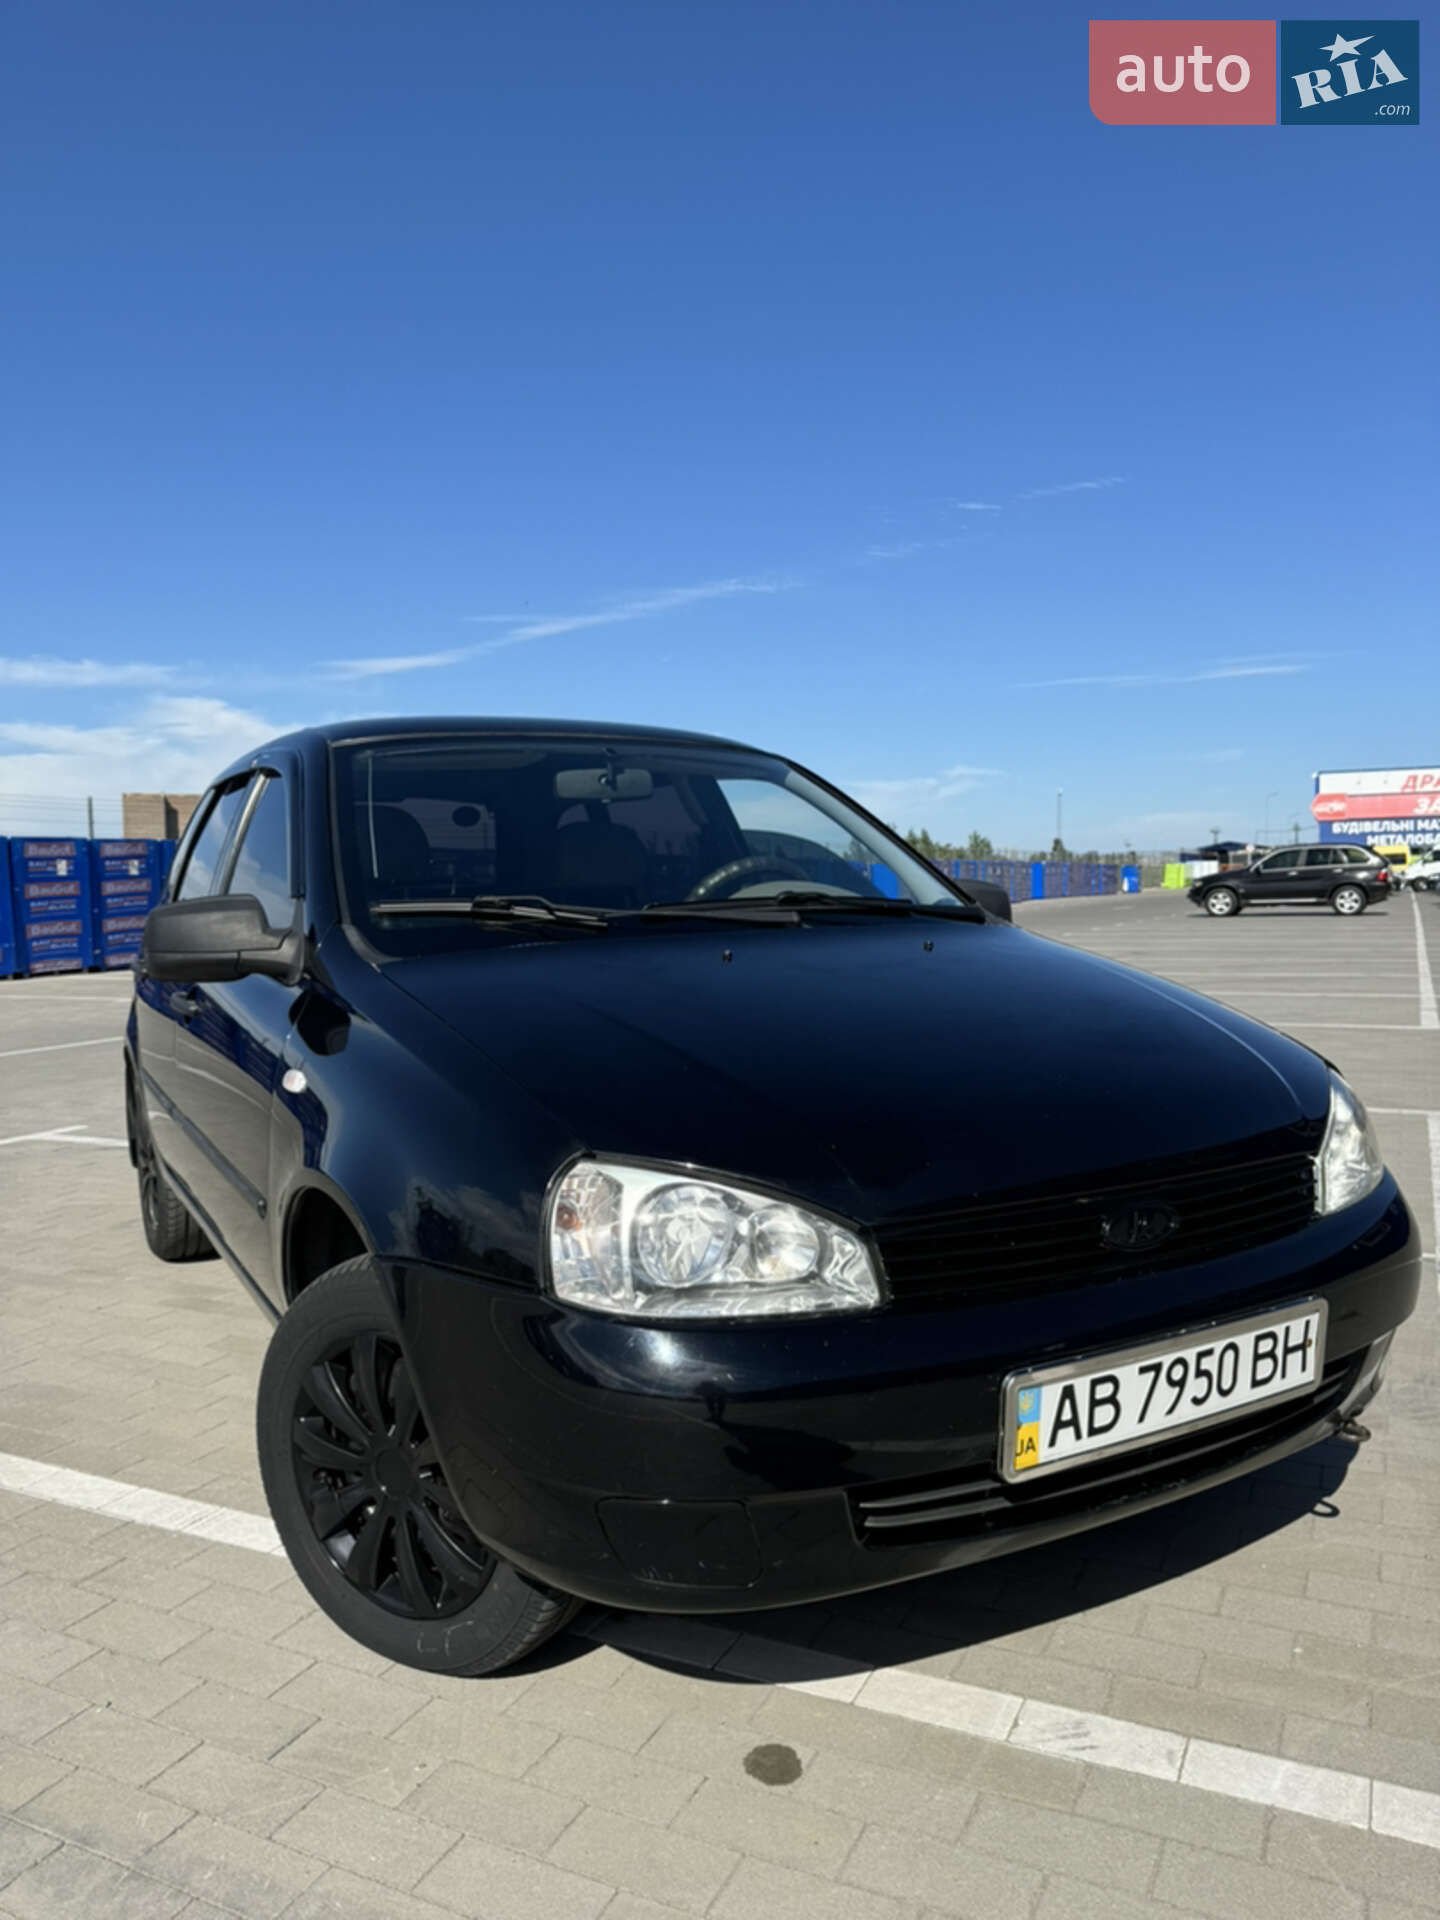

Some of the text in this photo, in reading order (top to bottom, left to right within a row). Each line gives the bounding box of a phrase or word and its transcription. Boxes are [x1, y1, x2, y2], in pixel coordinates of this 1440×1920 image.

[1332, 819, 1414, 835] БУДІВЕЛЬНІ
[1047, 1319, 1311, 1449] AB 7950 BH
